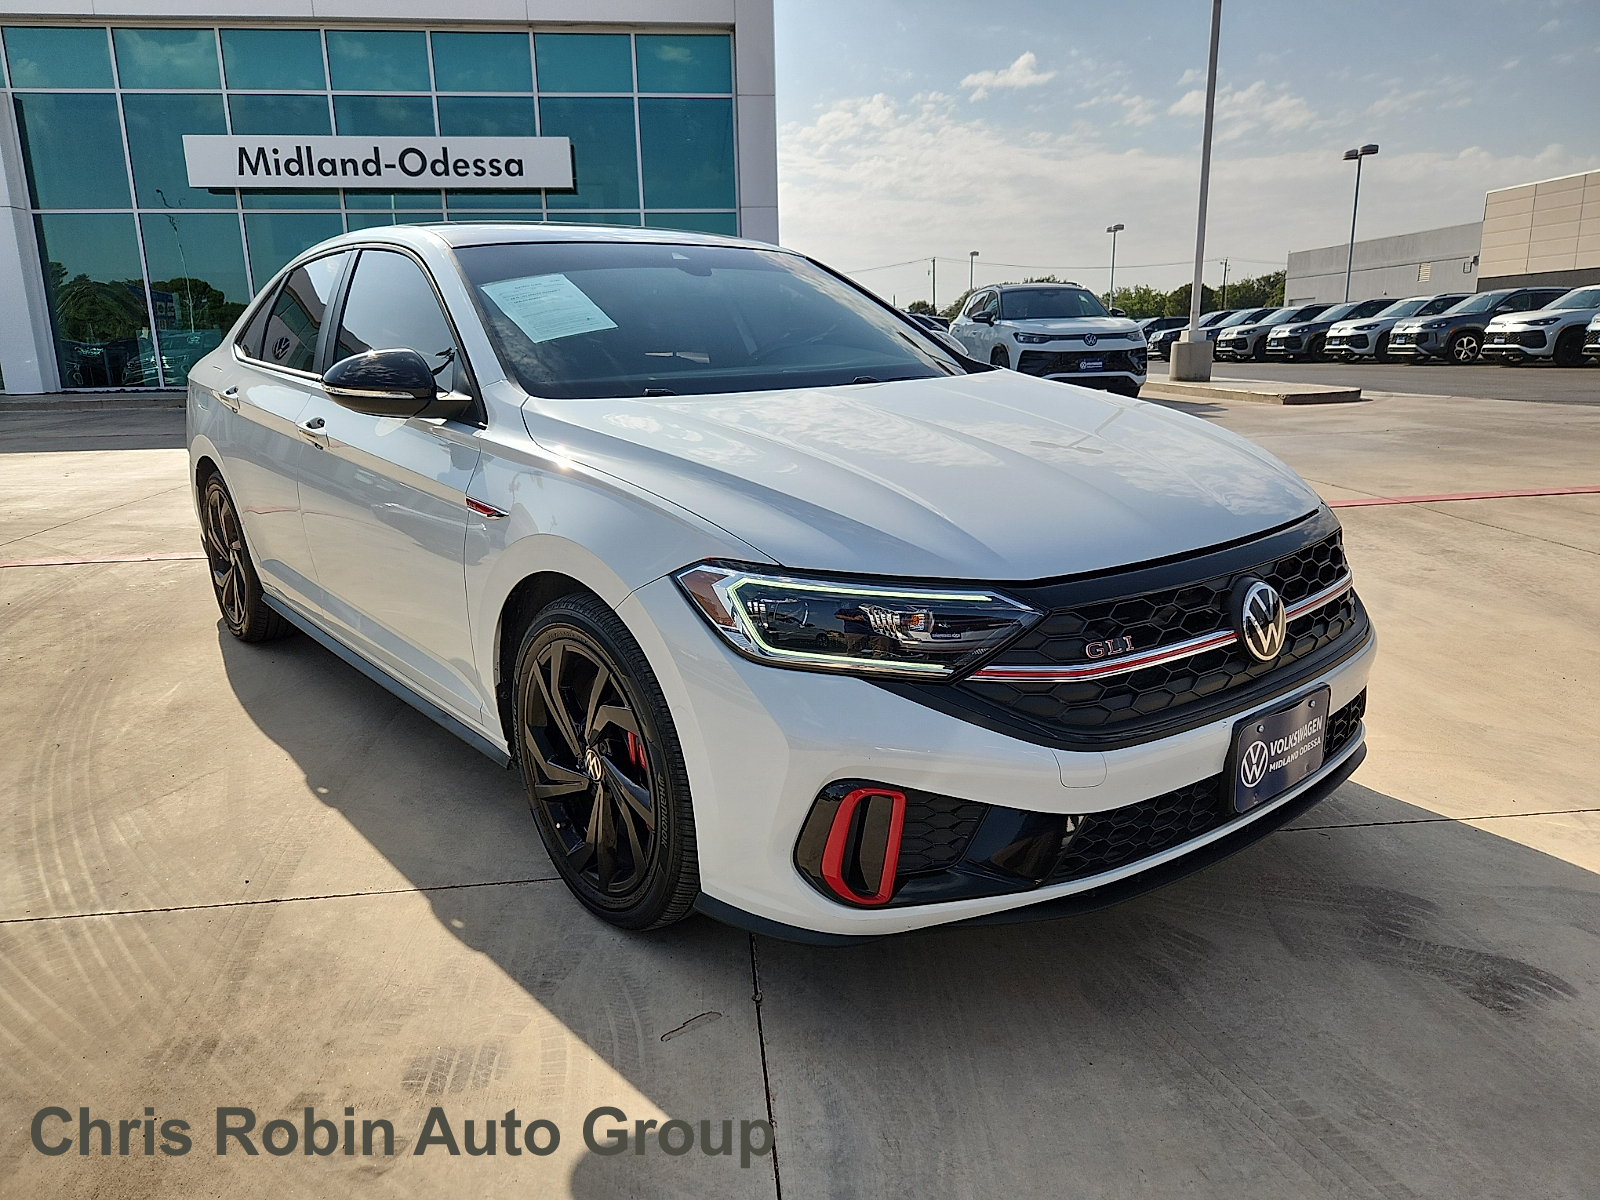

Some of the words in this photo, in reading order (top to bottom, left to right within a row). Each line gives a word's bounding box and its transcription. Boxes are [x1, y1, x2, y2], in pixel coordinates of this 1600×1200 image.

[237, 146, 524, 178] Midland-Odessa
[1242, 581, 1287, 661] VW
[1085, 635, 1135, 659] GLI
[1268, 750, 1299, 773] MIDLAND
[1299, 736, 1322, 756] ODESSA
[1269, 715, 1323, 757] VOLKSWAGEN
[1240, 740, 1269, 788] VW
